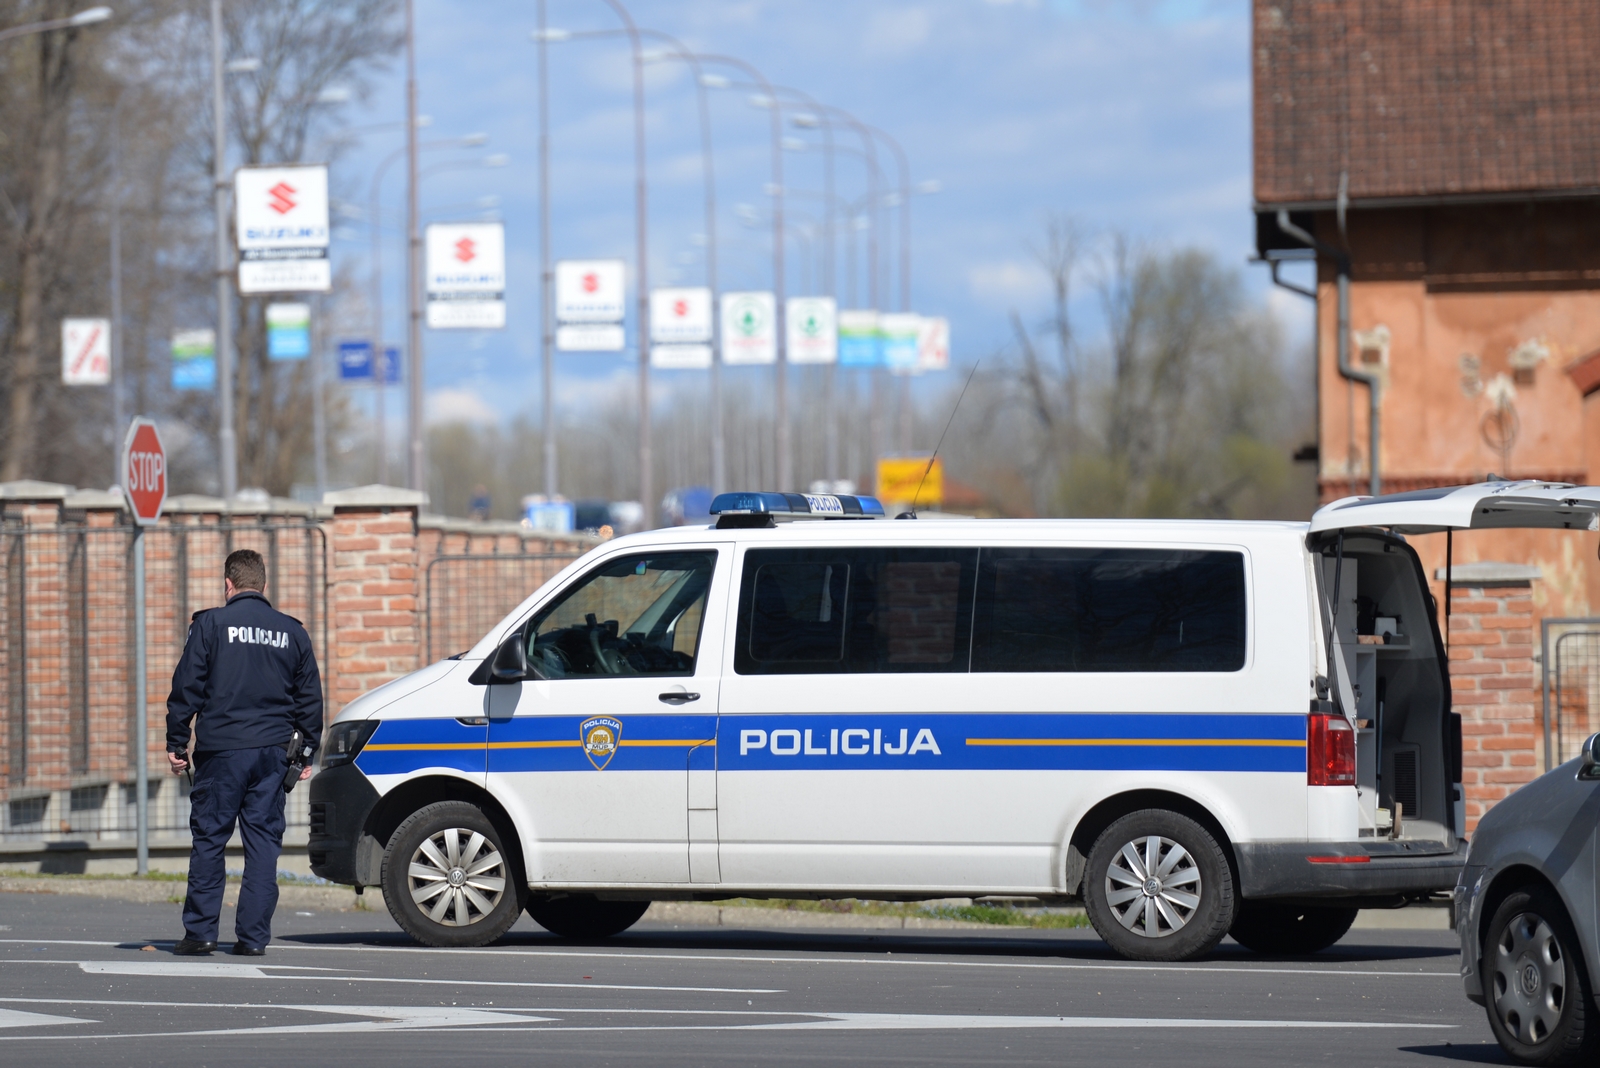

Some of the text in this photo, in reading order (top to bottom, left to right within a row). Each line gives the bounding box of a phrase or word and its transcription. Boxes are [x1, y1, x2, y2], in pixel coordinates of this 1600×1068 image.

[130, 450, 163, 493] STOP
[806, 496, 842, 512] POLICIJA
[227, 626, 290, 649] POLICIJA
[583, 719, 620, 730] POLICIJA
[739, 728, 943, 756] POLICIJA
